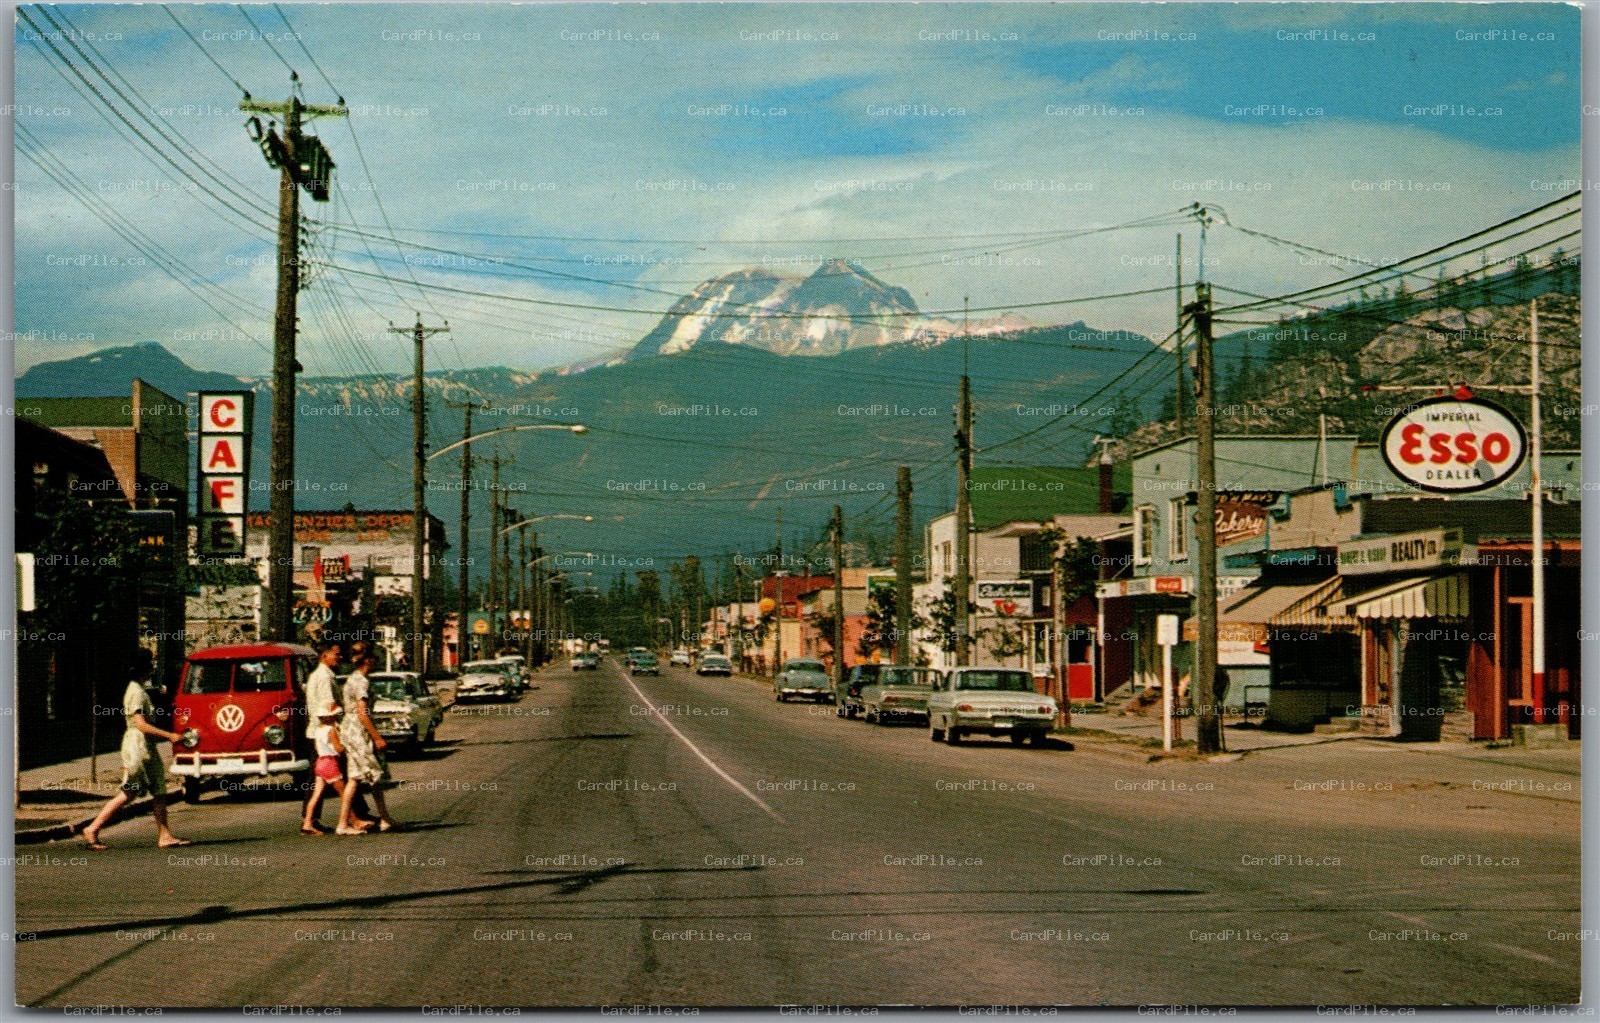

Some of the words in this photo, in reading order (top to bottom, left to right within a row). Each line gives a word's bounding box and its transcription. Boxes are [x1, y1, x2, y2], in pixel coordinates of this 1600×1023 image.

[1426, 412, 1482, 422] IMPERIAL
[208, 398, 237, 550] CAFE
[1426, 469, 1482, 480] DEALER
[1391, 538, 1427, 563] REALTY
